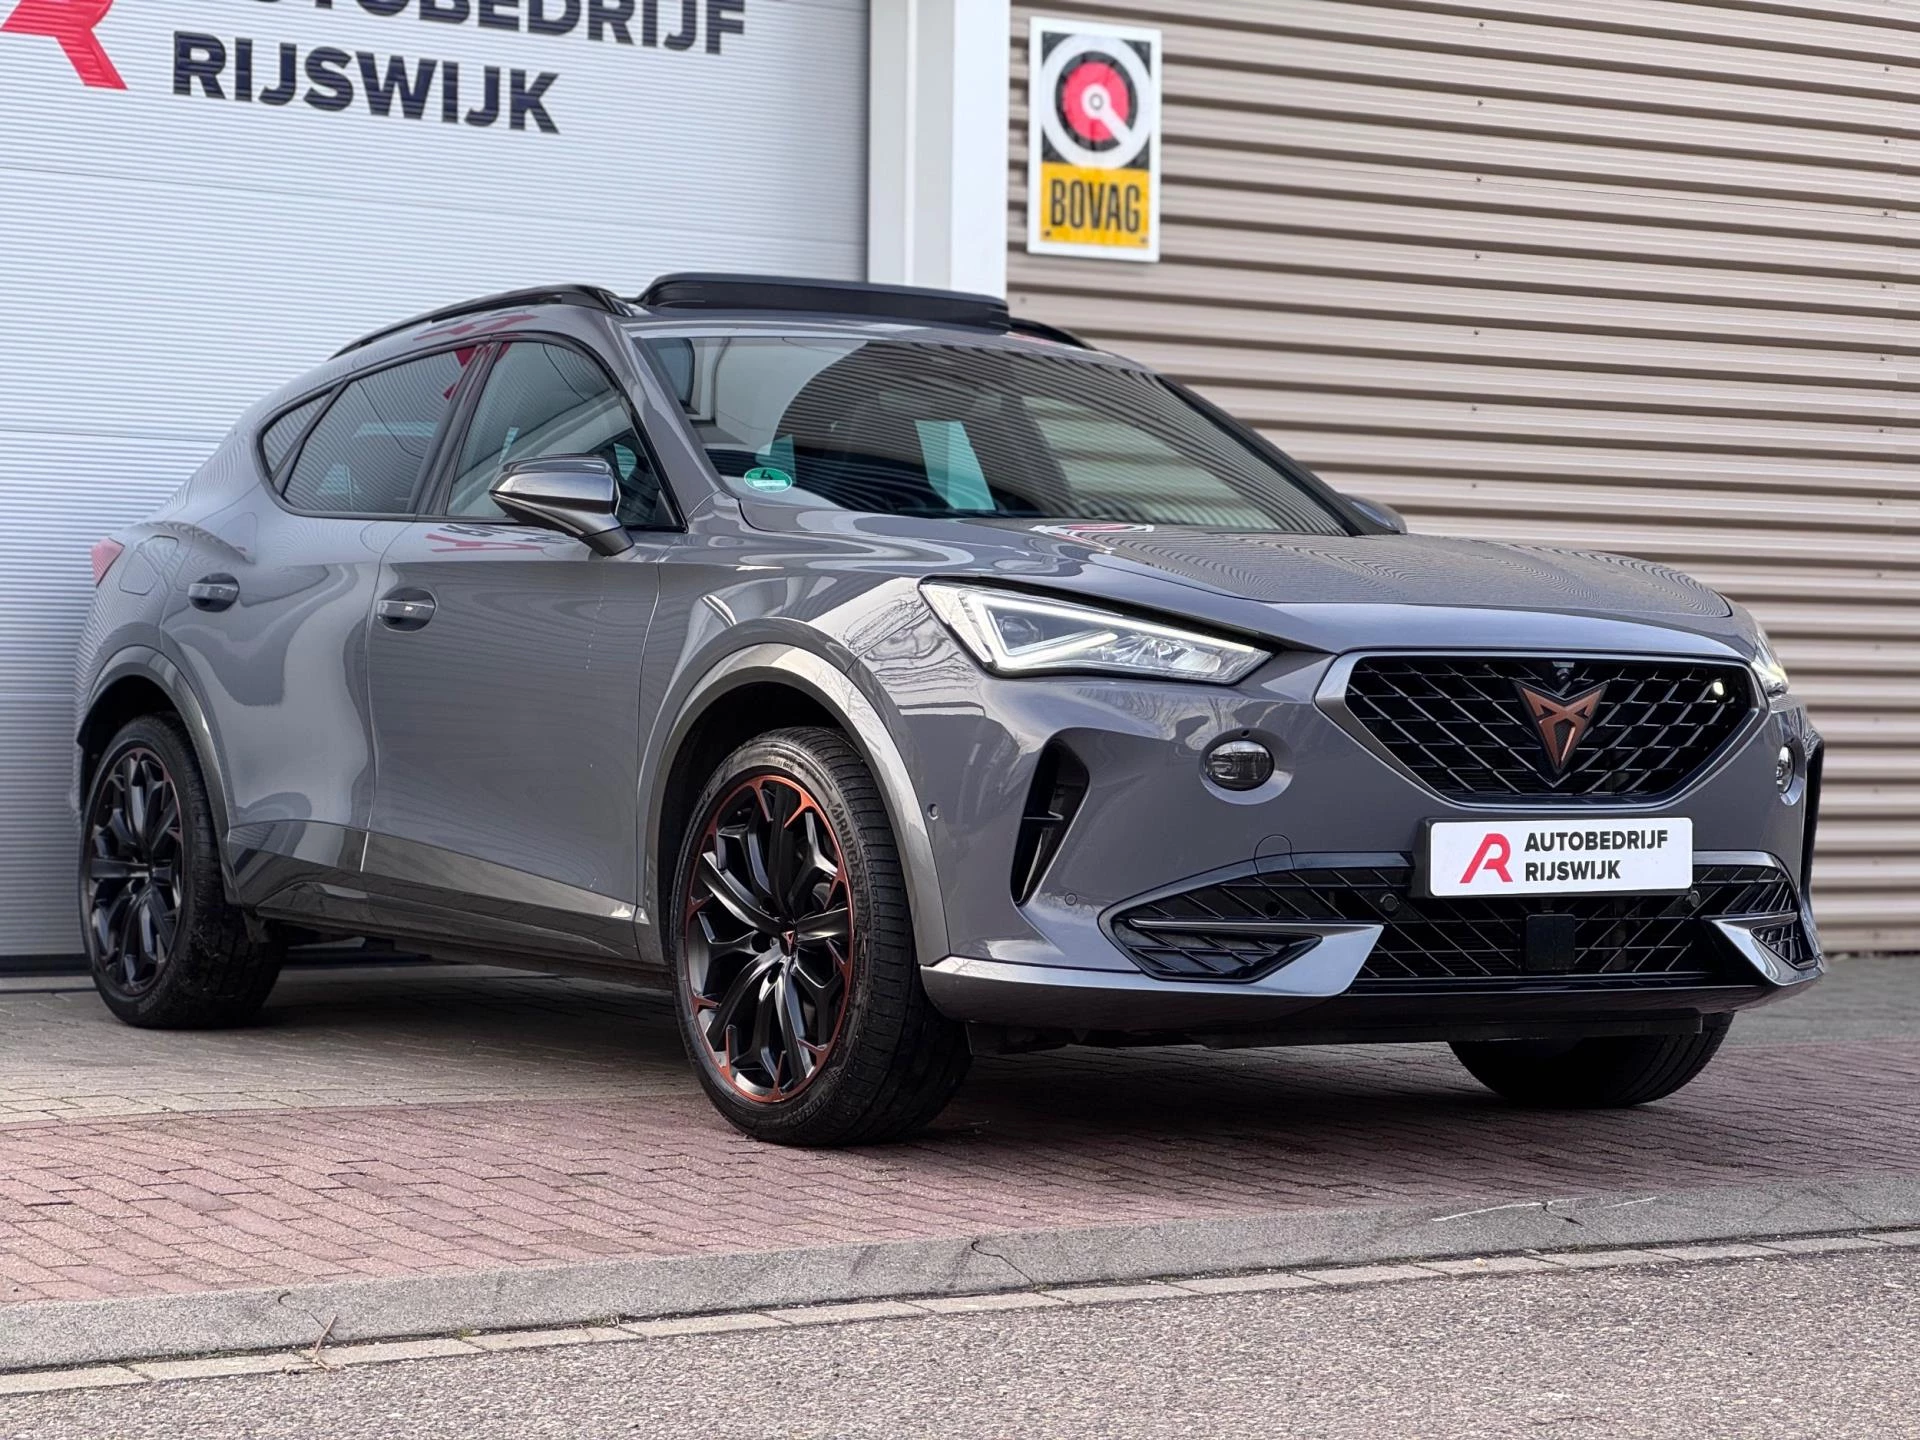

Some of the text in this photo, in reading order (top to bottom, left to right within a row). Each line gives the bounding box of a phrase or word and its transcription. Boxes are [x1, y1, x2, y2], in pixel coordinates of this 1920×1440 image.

[173, 31, 560, 134] RIJSWIJK
[1050, 179, 1140, 233] BOVAG
[1524, 829, 1668, 852] AUTOBEDRIJF
[1525, 860, 1621, 882] RIJSWIJK
